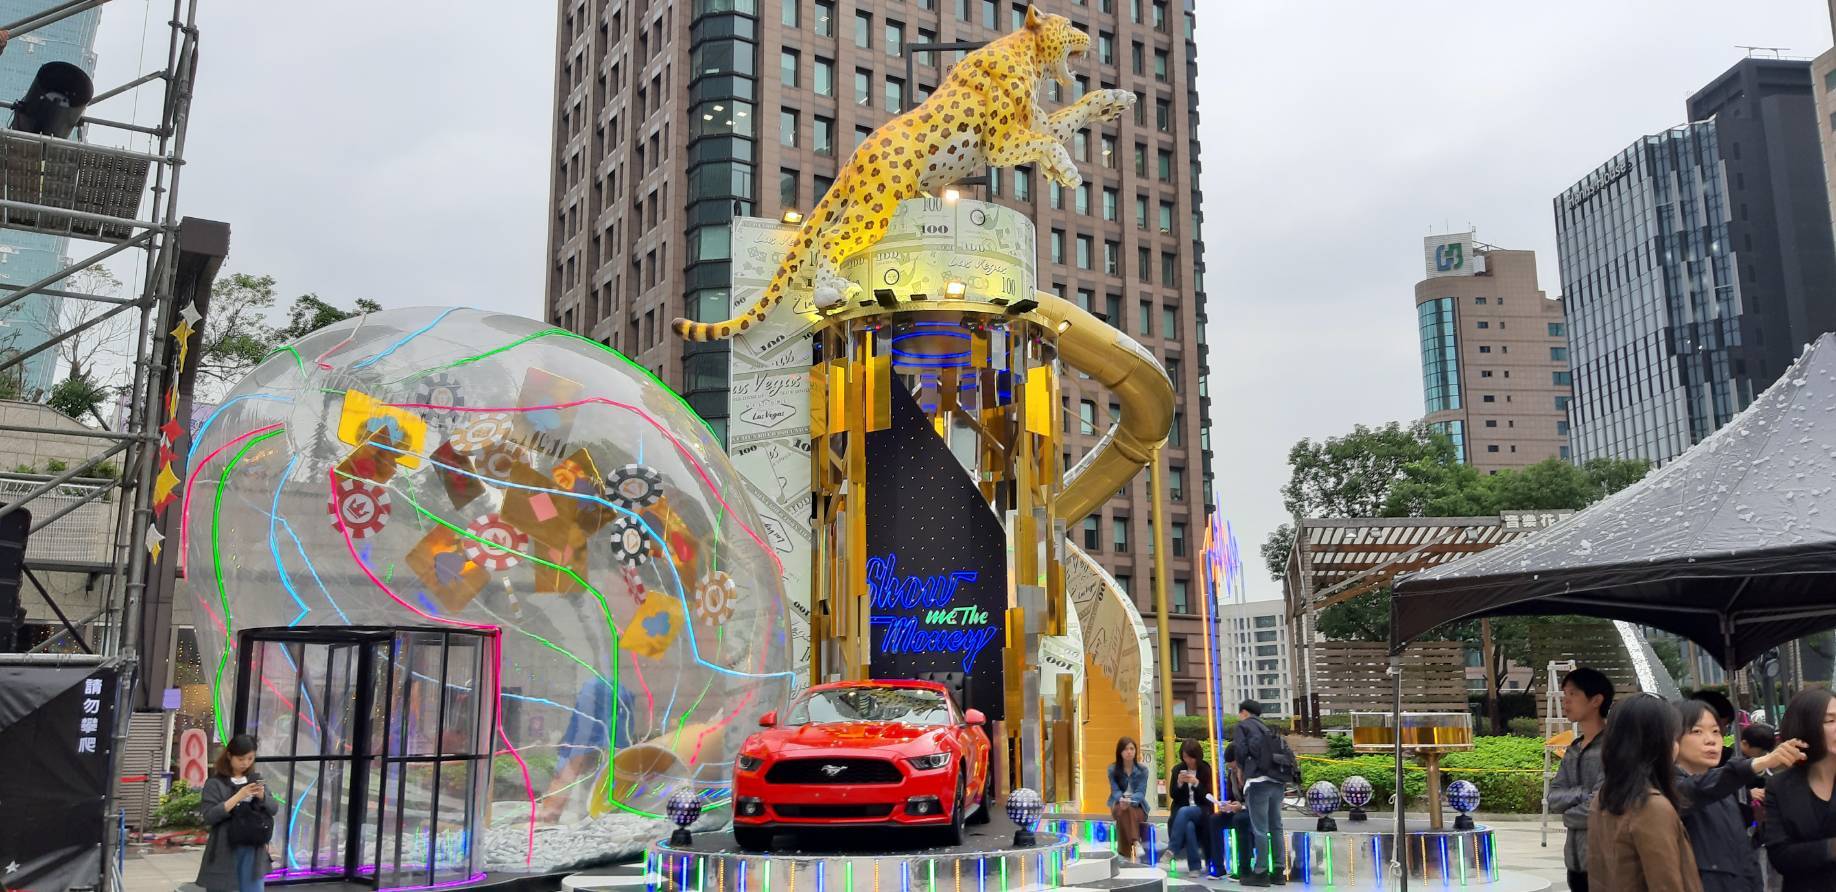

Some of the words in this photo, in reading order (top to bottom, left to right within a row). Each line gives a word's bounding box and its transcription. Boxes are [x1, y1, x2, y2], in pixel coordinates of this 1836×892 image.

[922, 198, 943, 212] 100
[922, 225, 949, 234] 100
[948, 256, 973, 269] Las
[975, 259, 1007, 276] Vegas
[1002, 276, 1015, 295] 100
[734, 296, 746, 307] 00
[733, 384, 749, 395] as
[755, 372, 801, 398] Vegas
[753, 412, 764, 420] Las
[765, 411, 785, 421] Vegas
[738, 445, 757, 456] 100
[793, 440, 811, 452] 10
[866, 552, 978, 609] Show
[954, 604, 989, 626] The
[868, 615, 998, 674] Money
[1046, 656, 1073, 670] 100
[78, 678, 103, 753] 請勿攀爬
